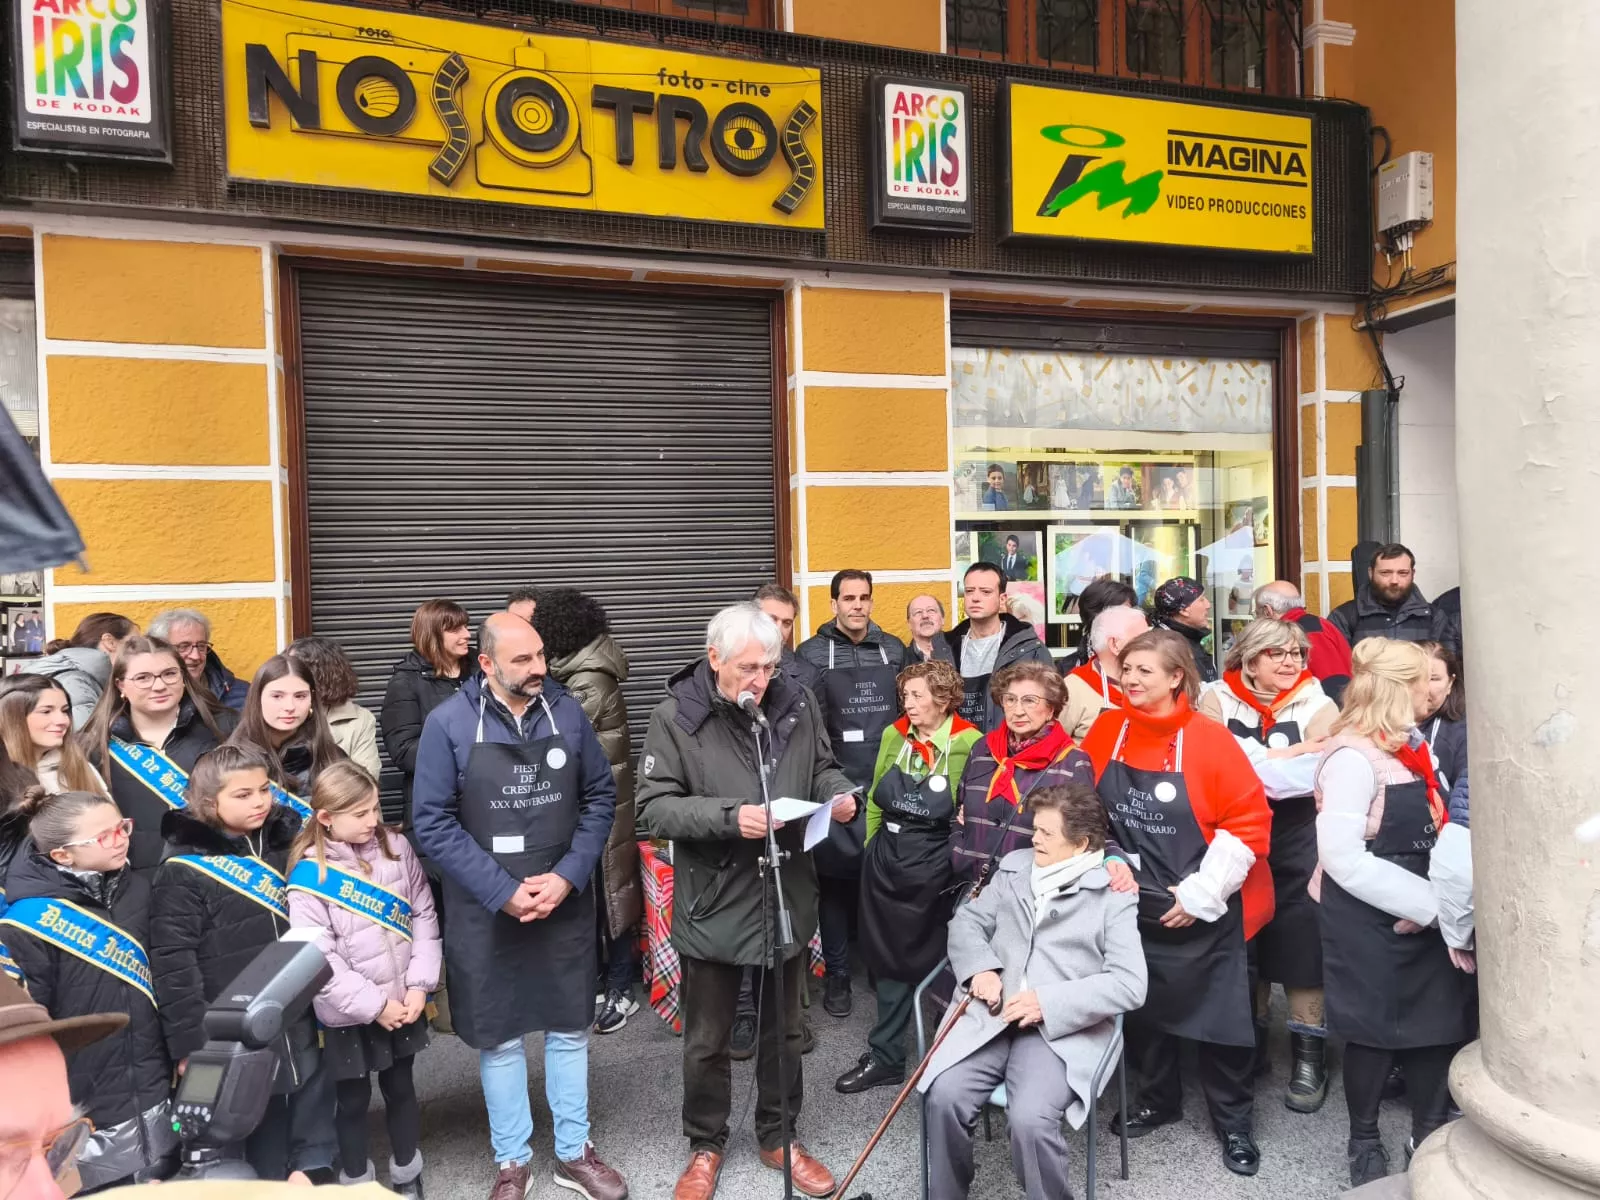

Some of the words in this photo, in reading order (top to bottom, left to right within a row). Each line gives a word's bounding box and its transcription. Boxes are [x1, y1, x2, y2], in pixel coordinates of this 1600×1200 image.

[33, 15, 140, 104] IRIS
[657, 67, 704, 90] foto
[726, 79, 771, 97] cine
[36, 98, 61, 109] DE
[73, 102, 140, 116] KODAK
[893, 91, 959, 121] ARCO
[27, 121, 87, 134] ESPECIALISTAS
[892, 117, 960, 188] IRIS
[1167, 139, 1307, 178] IMAGINA
[893, 184, 909, 192] DE
[917, 186, 960, 196] KODAK
[887, 201, 926, 212] ESPECIALISTAS
[1166, 194, 1205, 211] VIDEO
[1208, 198, 1307, 219] PRODUCCIONES
[490, 800, 511, 809] XXX
[513, 792, 562, 809] ANIVERSARIO
[36, 903, 98, 949] Dama
